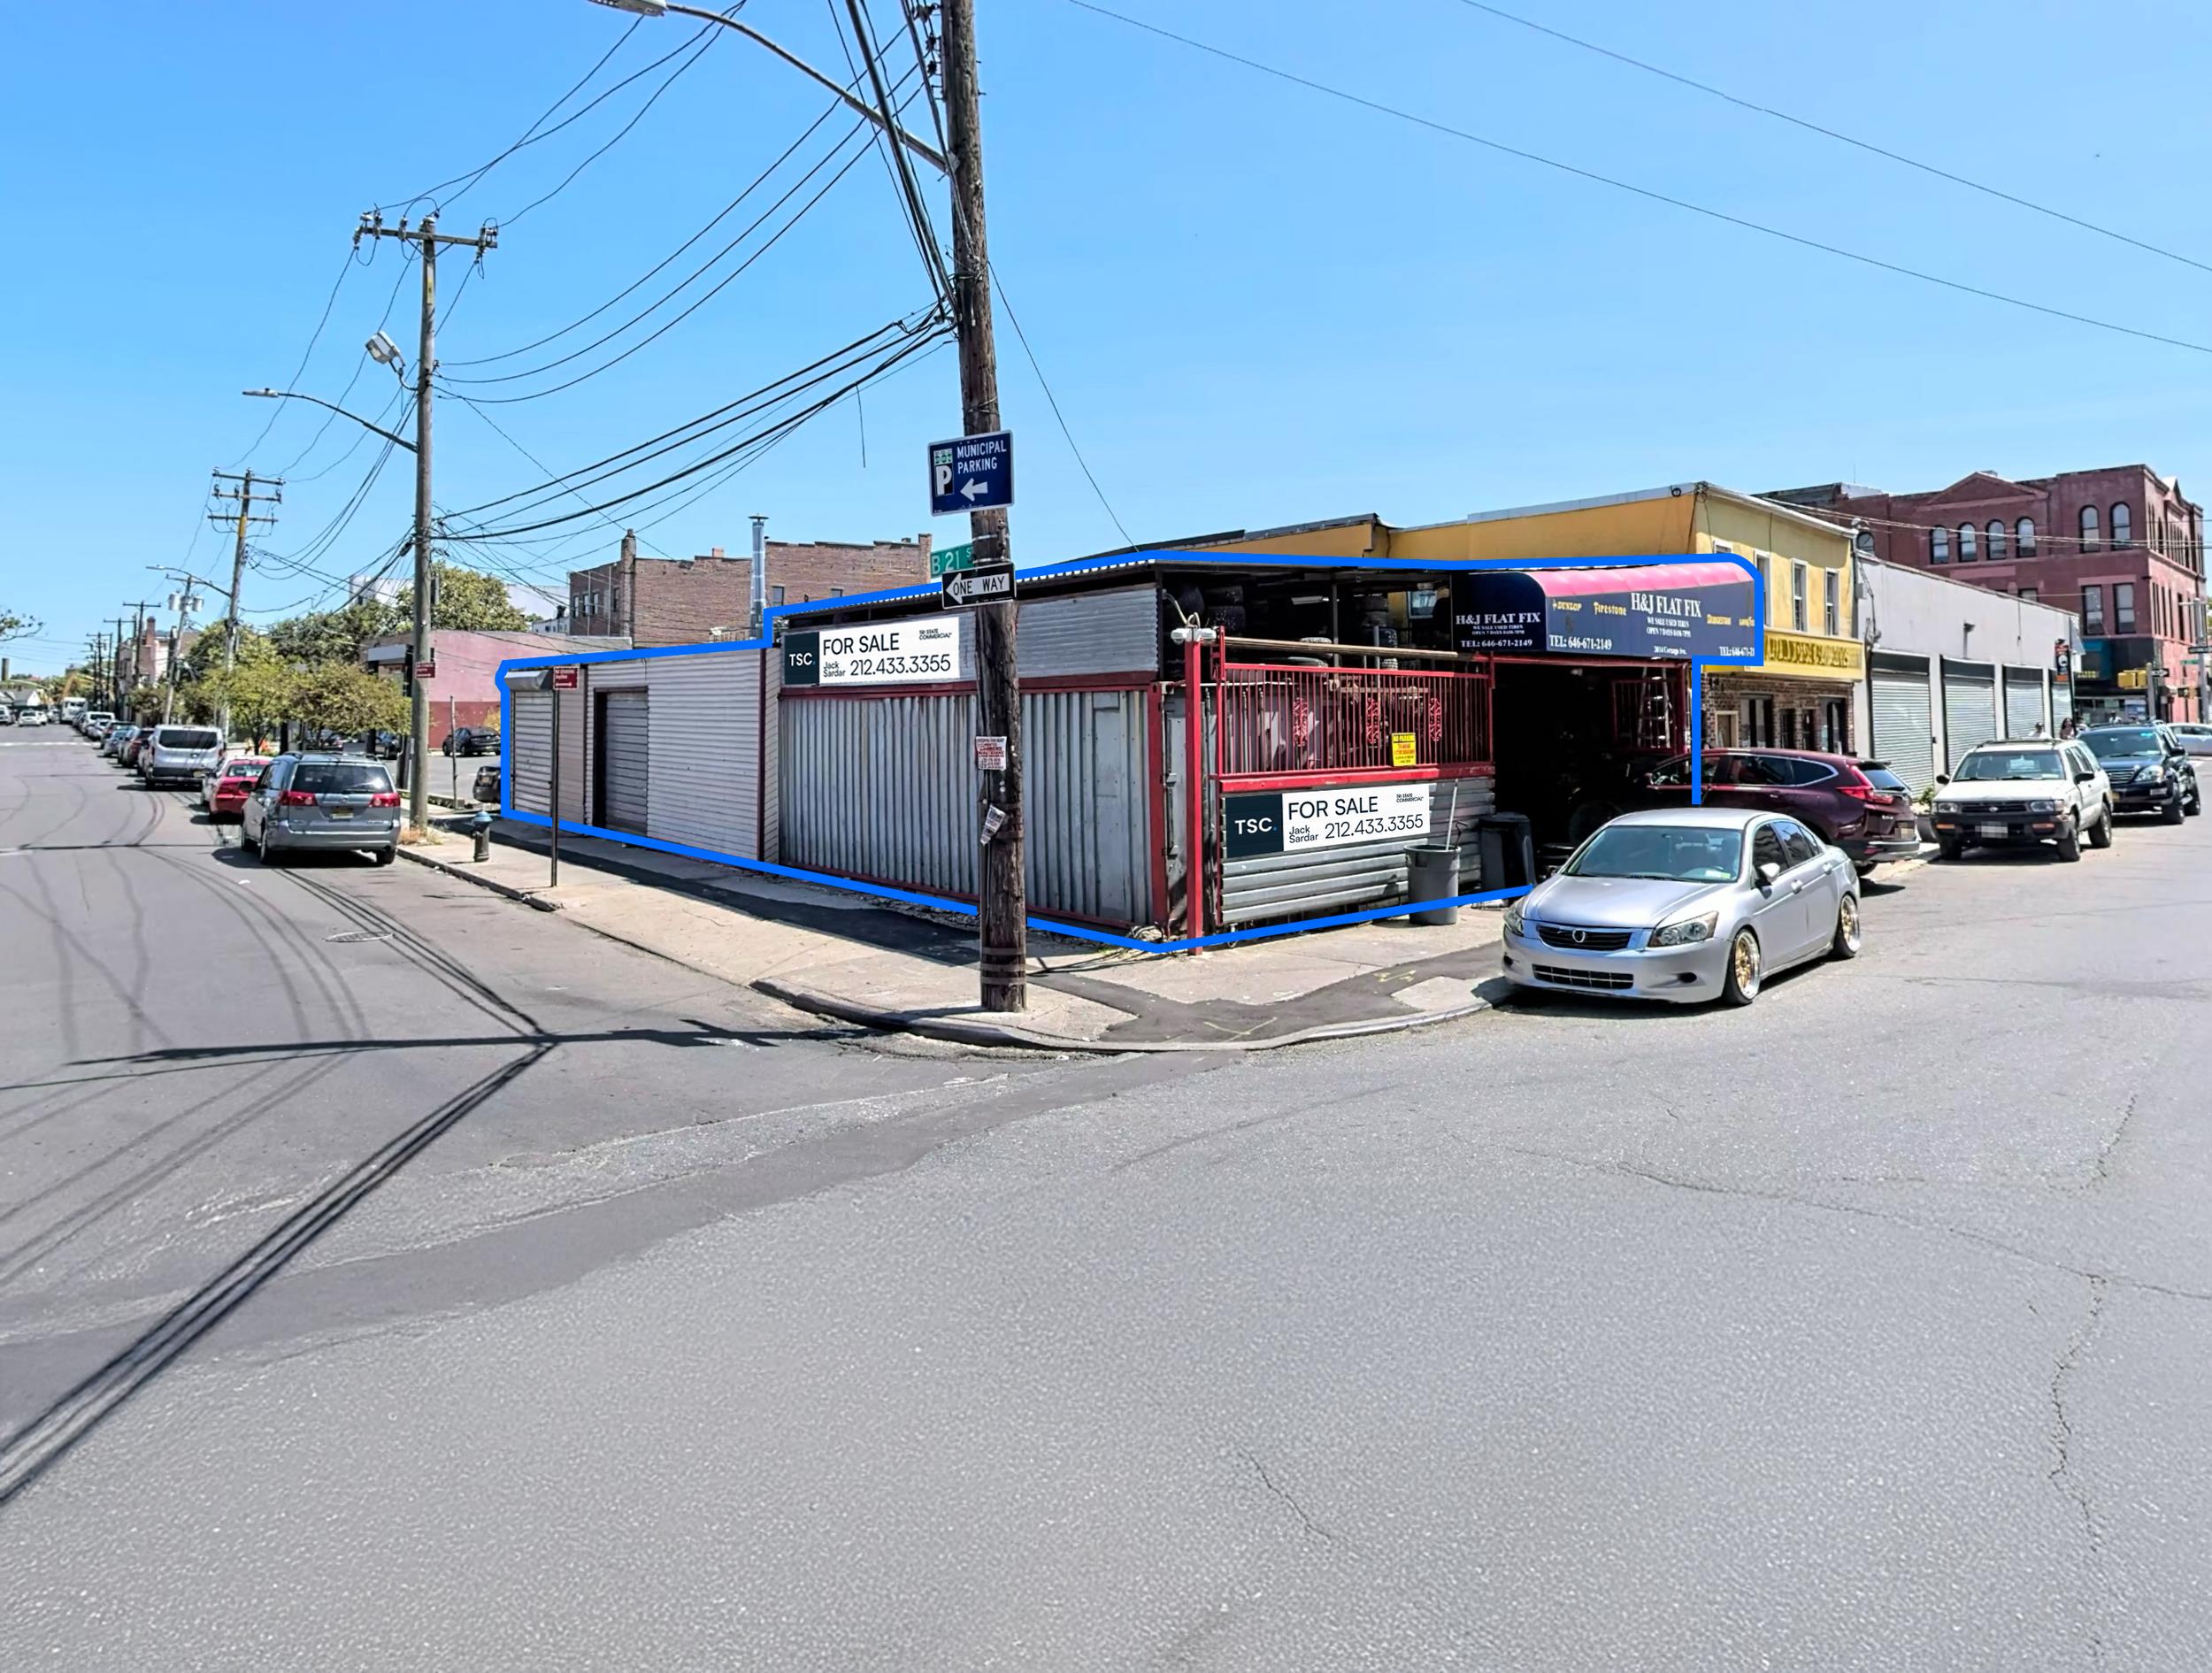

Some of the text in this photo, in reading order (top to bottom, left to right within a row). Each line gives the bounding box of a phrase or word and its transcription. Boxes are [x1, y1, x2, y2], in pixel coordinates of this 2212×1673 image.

[956, 440, 1007, 459] MUNICIPAL
[957, 457, 997, 475] PARKING
[932, 555, 941, 575] B
[945, 551, 960, 572] 21
[953, 576, 1005, 595] ONE WAY
[1557, 601, 1582, 611] DUNLOP
[1631, 593, 1702, 618] H&J FLAT FIX
[1455, 612, 1540, 625] H&J FLAT FIX
[823, 633, 900, 656] FOR SALE
[1549, 634, 1612, 650] TEL: 646-671-2149
[824, 661, 839, 670] Jack
[824, 669, 846, 678] Sardar
[850, 653, 951, 676] 212.433.3355
[1288, 796, 1379, 820] FOR SALE
[1289, 825, 1310, 835] Jack
[1325, 813, 1424, 839] 212.433.3355
[1289, 833, 1318, 843] Sardar
